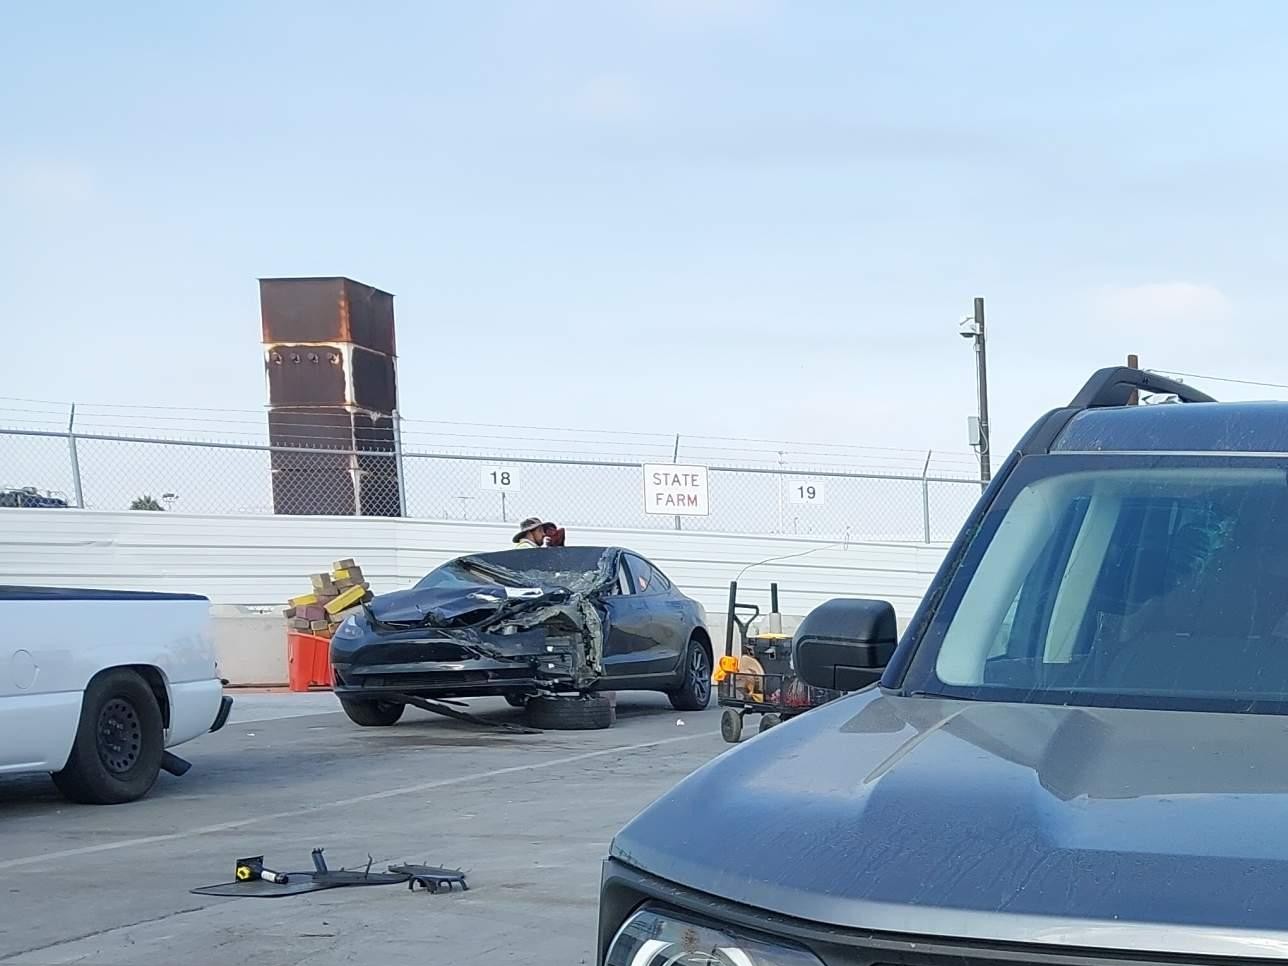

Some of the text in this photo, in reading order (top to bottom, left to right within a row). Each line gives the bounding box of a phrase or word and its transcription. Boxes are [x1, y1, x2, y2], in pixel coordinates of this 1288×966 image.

[490, 471, 511, 486] 18
[653, 473, 700, 487] STATE
[656, 493, 698, 507] FARM
[797, 486, 816, 500] 19
